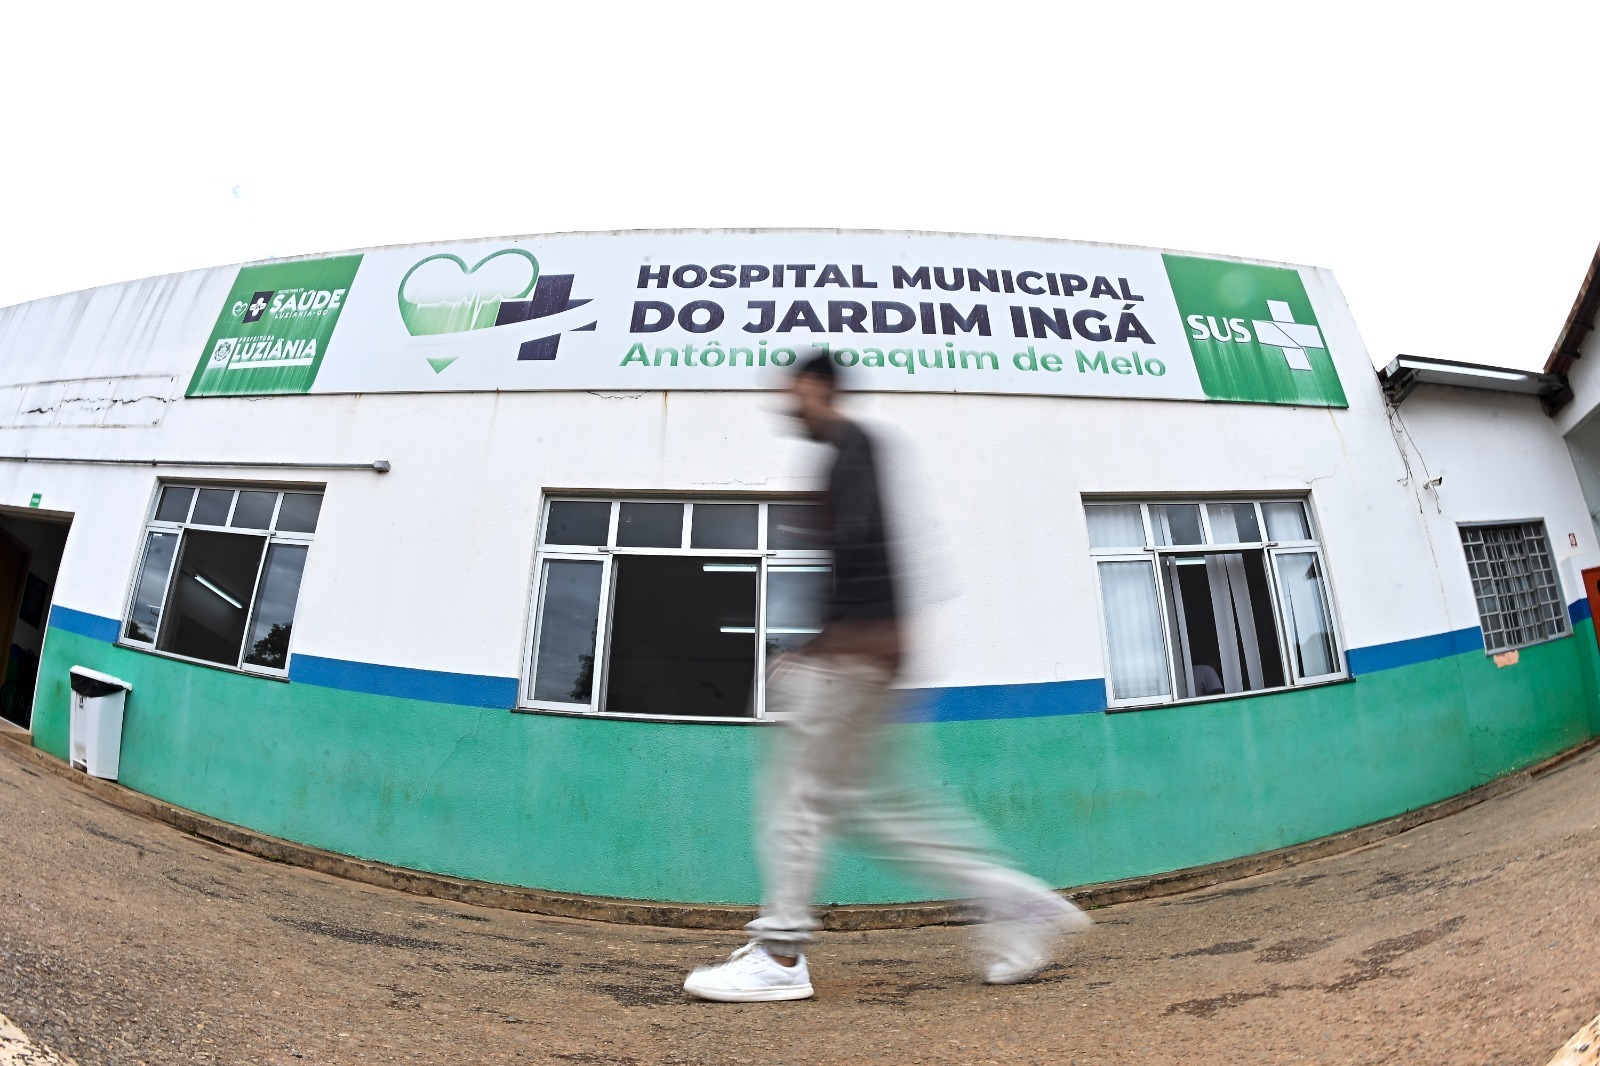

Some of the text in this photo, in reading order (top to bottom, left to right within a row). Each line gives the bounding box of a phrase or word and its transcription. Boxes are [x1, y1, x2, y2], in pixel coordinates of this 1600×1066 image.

[637, 264, 1144, 301] HOSPITAL MUNICIPAL
[269, 288, 346, 312] SAÚDE
[630, 300, 1156, 344] DO JARDIM INGÁ
[1187, 314, 1252, 343] SUS
[232, 339, 317, 360] LUZIÂNIA
[619, 340, 797, 368] Antônio
[1013, 347, 1063, 372] de
[1074, 349, 1166, 377] Melo
